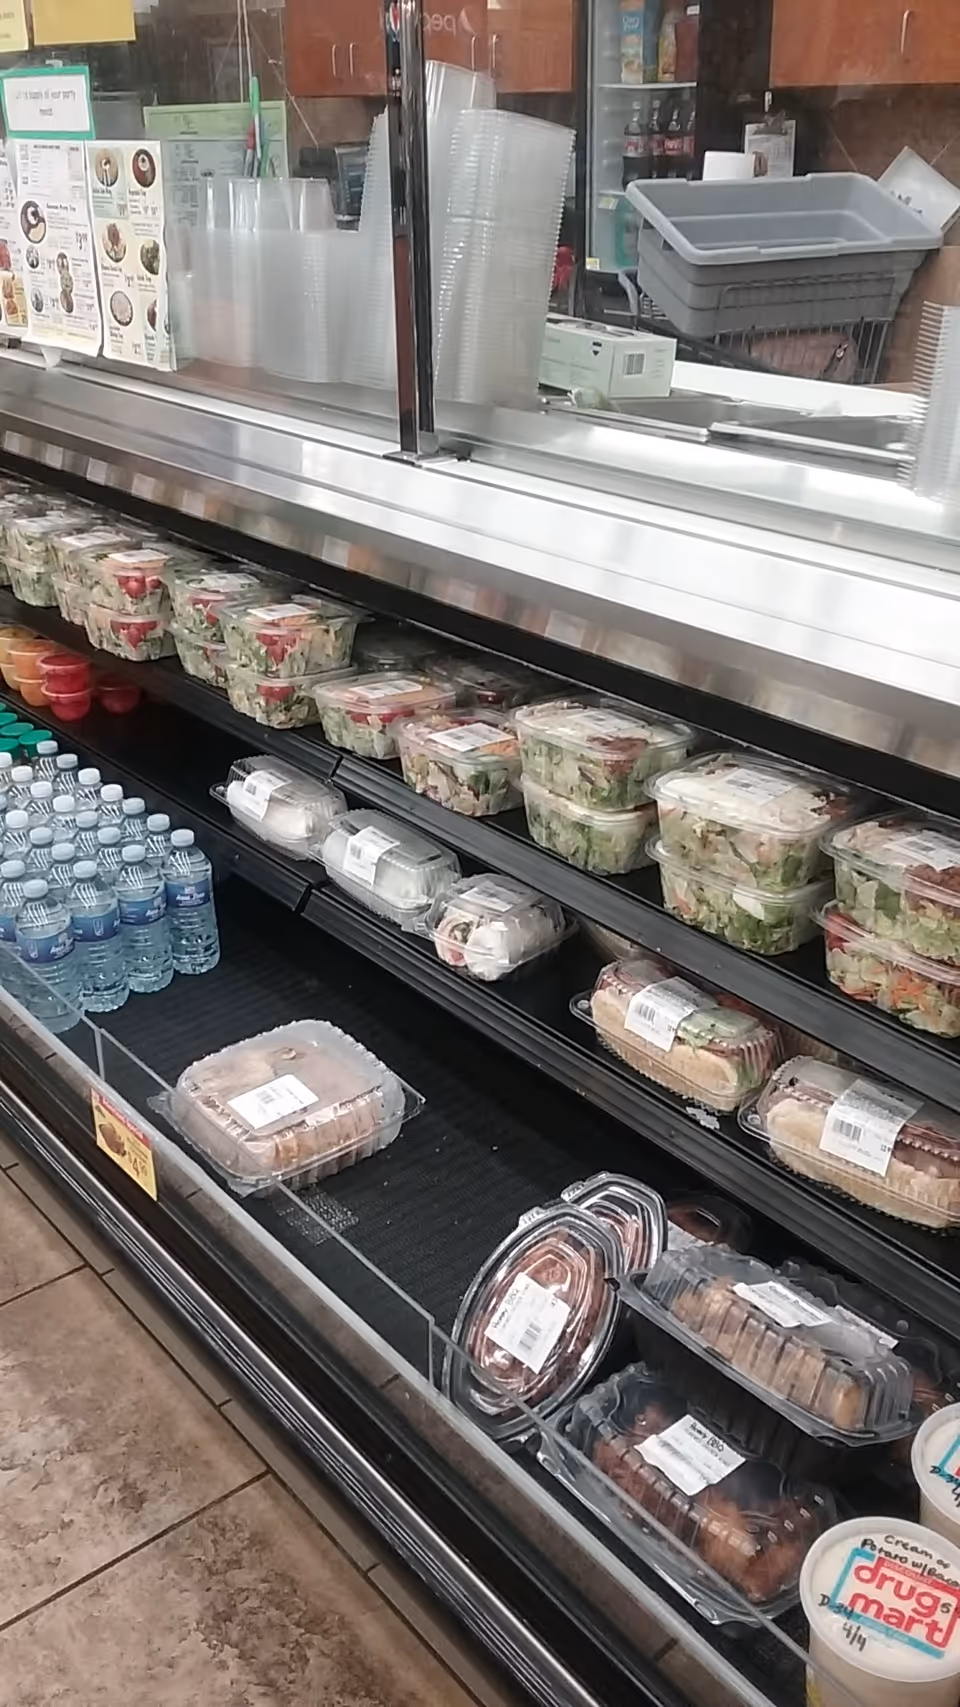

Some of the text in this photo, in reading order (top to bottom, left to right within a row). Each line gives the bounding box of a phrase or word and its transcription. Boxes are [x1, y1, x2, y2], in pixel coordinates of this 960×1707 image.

[883, 1534, 933, 1560] Cream
[853, 1557, 942, 1619] drug
[842, 1621, 867, 1653] 4/4
[847, 1592, 948, 1649] mart
